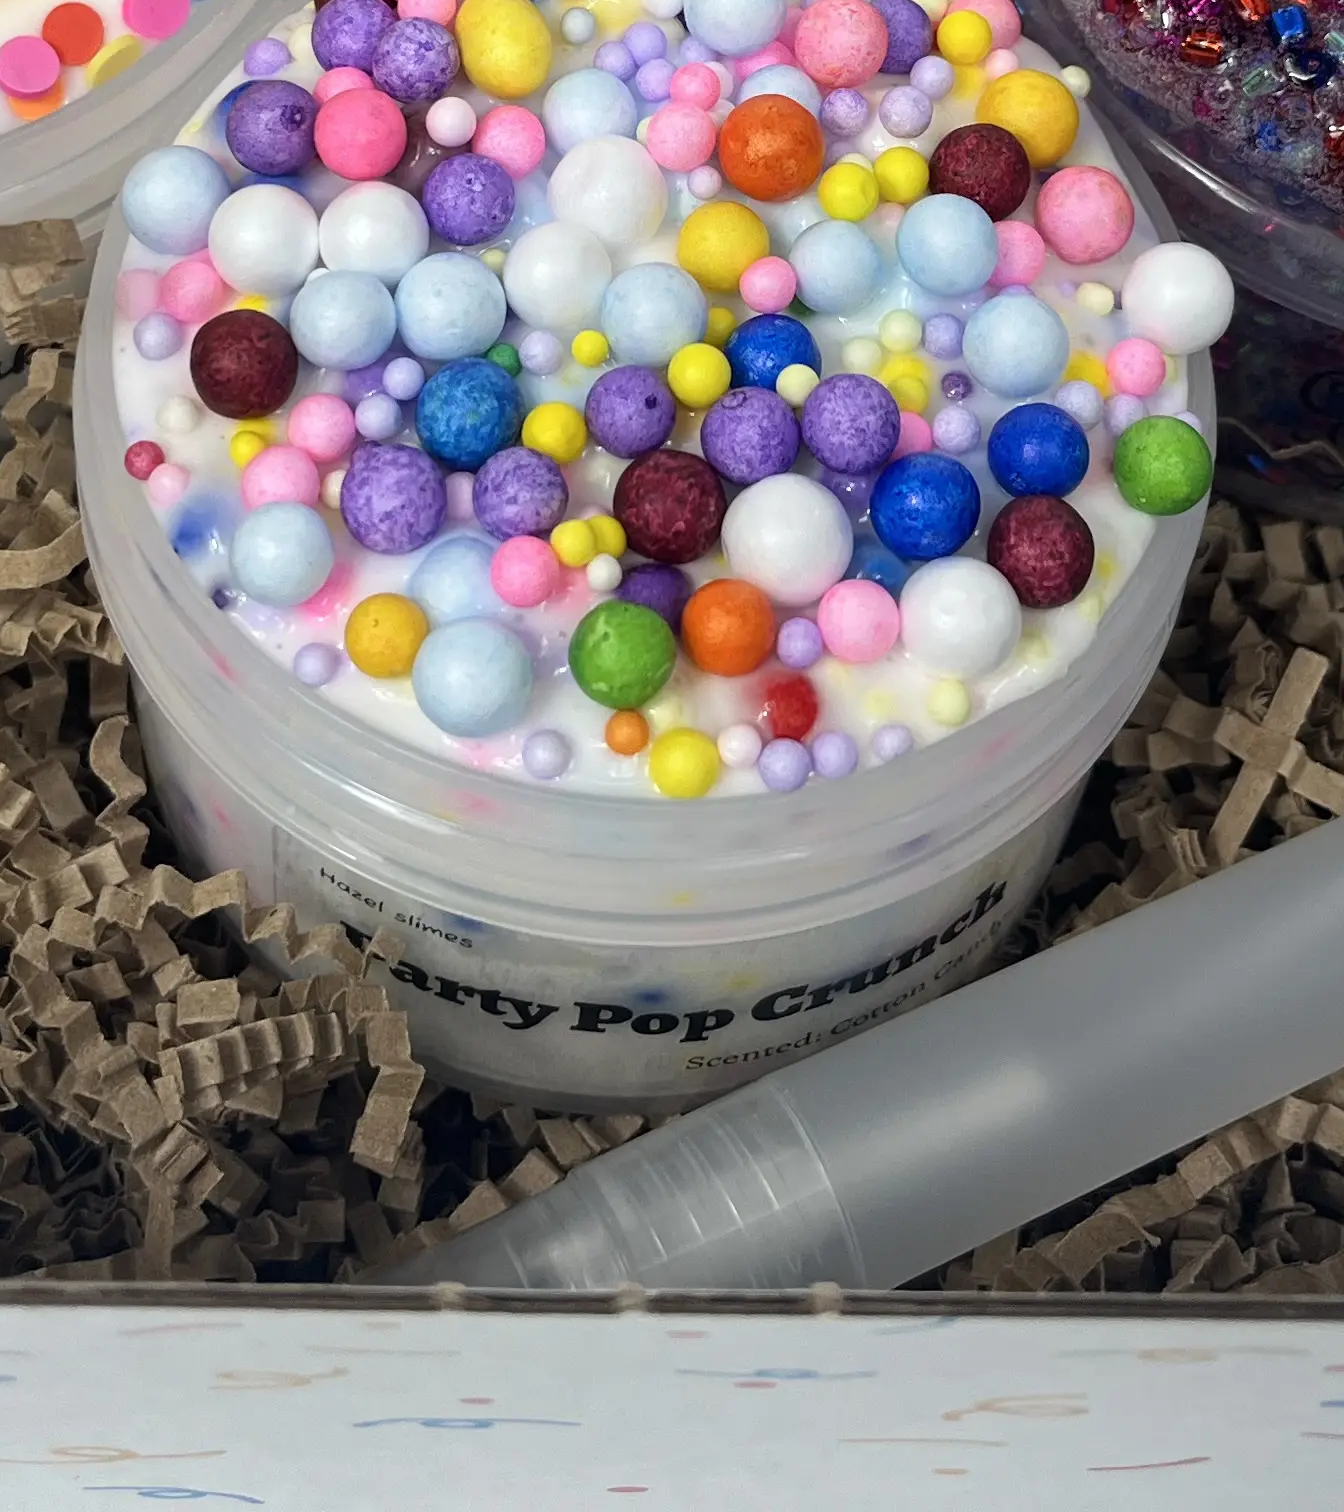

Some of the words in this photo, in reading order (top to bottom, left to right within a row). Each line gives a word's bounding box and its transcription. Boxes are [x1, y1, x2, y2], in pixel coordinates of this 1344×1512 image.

[319, 866, 385, 913] Hazel
[393, 911, 474, 949] slimes
[568, 1000, 736, 1044] Pop
[750, 881, 1008, 1022] Crunch
[685, 1034, 823, 1071] Scented:
